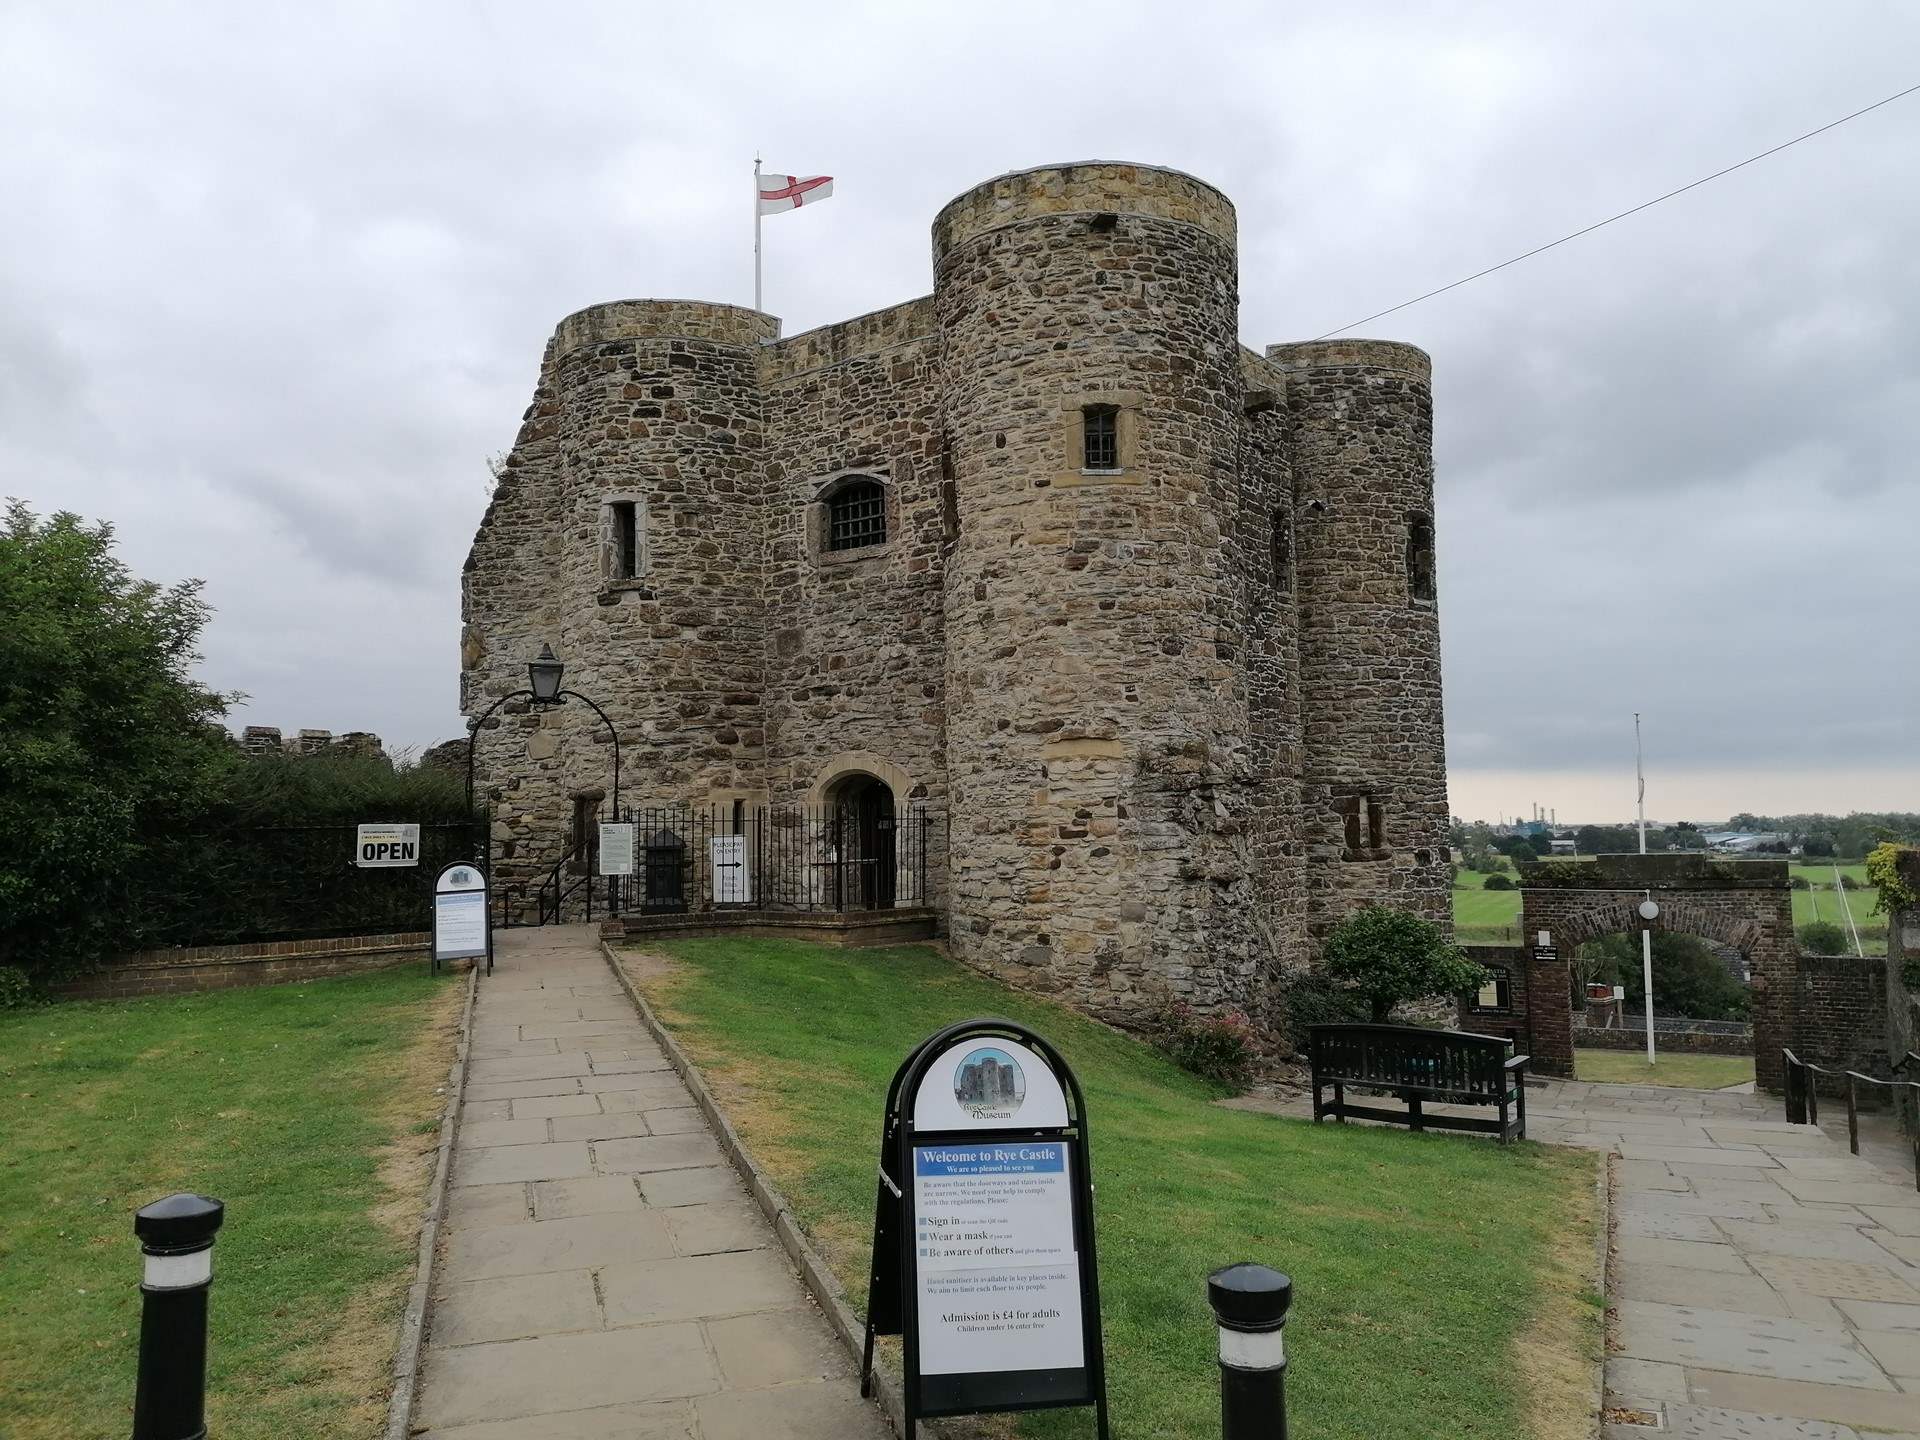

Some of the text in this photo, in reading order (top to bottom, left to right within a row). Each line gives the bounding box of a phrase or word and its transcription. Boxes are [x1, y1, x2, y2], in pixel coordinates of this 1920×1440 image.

[363, 842, 414, 861] OPEN
[972, 1110, 1011, 1119] Museum
[923, 1148, 1055, 1164] Welcome to Rye Castle
[979, 1165, 1002, 1174] pleased
[978, 1180, 1007, 1188] doorways
[928, 1217, 948, 1228] Sign
[952, 1216, 960, 1225] in
[929, 1233, 953, 1241] Wear
[964, 1231, 988, 1240] mask
[929, 1248, 941, 1257] Be
[944, 1249, 971, 1257] aware
[974, 1246, 983, 1256] of
[985, 1246, 1014, 1255] others
[946, 1276, 971, 1284] sanitiser
[981, 1275, 1008, 1283] available
[1017, 1274, 1027, 1283] key
[1029, 1273, 1047, 1282] places
[977, 1284, 990, 1292] each
[941, 1308, 1060, 1323] Admission is £4 for adults
[957, 1324, 985, 1332] Children
